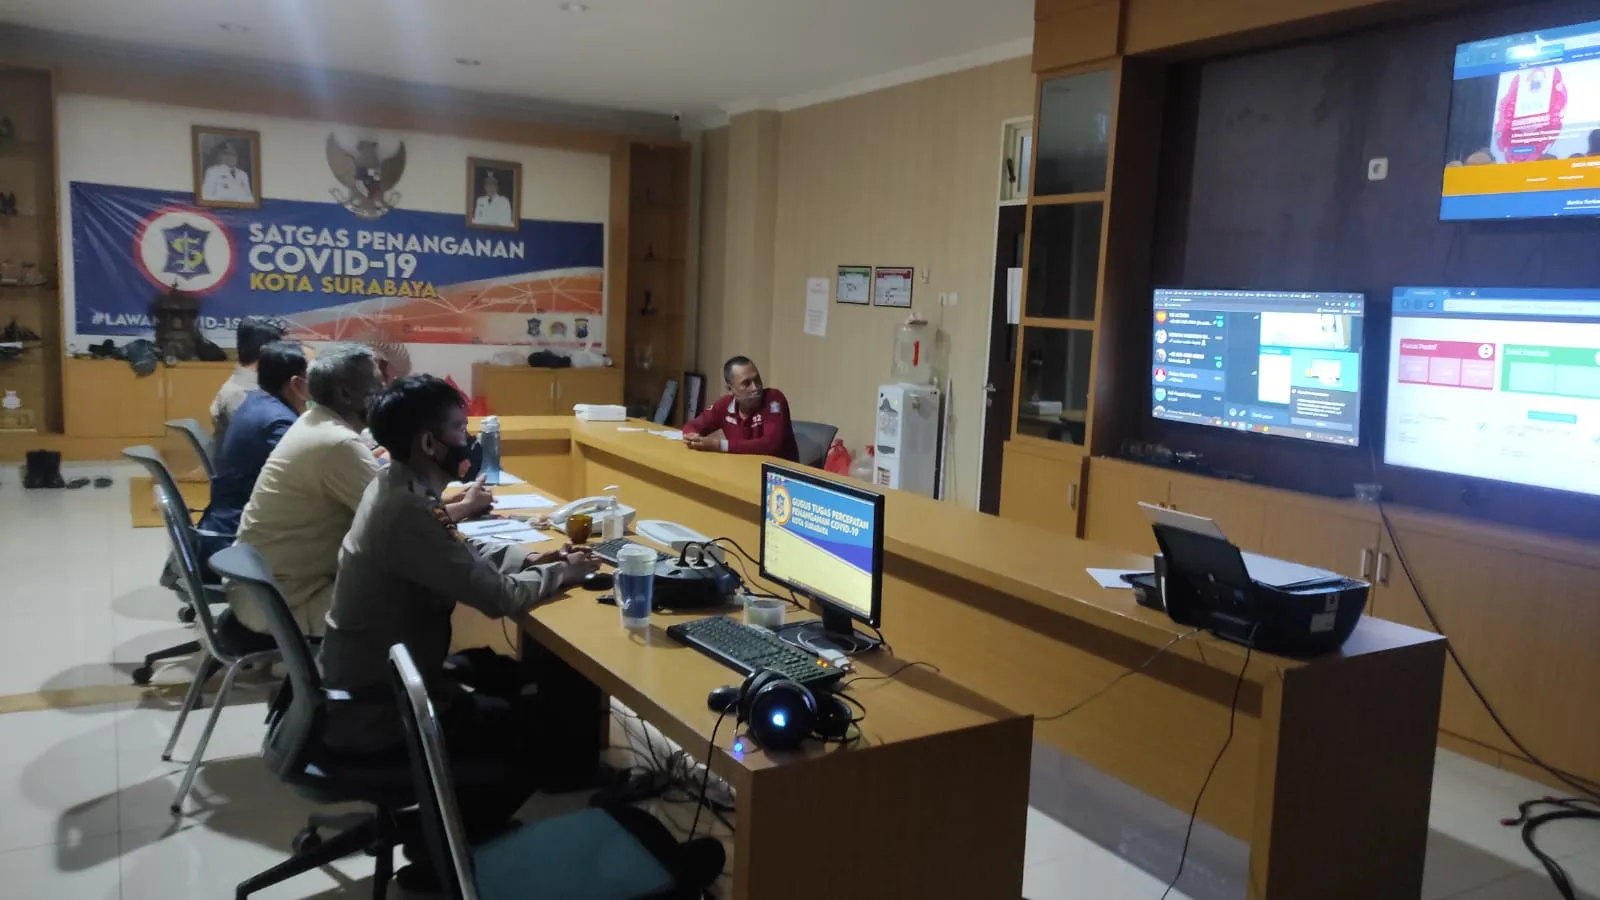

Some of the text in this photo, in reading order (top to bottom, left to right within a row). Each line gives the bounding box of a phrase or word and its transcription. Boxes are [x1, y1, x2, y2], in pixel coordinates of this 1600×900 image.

[249, 222, 525, 260] SATGAS PENANGANAN
[248, 243, 418, 279] COVID-19
[250, 272, 438, 298] KOTA SURABAYA
[791, 497, 869, 530] GUGUS TUGAS PERCEPATAN
[830, 520, 859, 537] COVID-19
